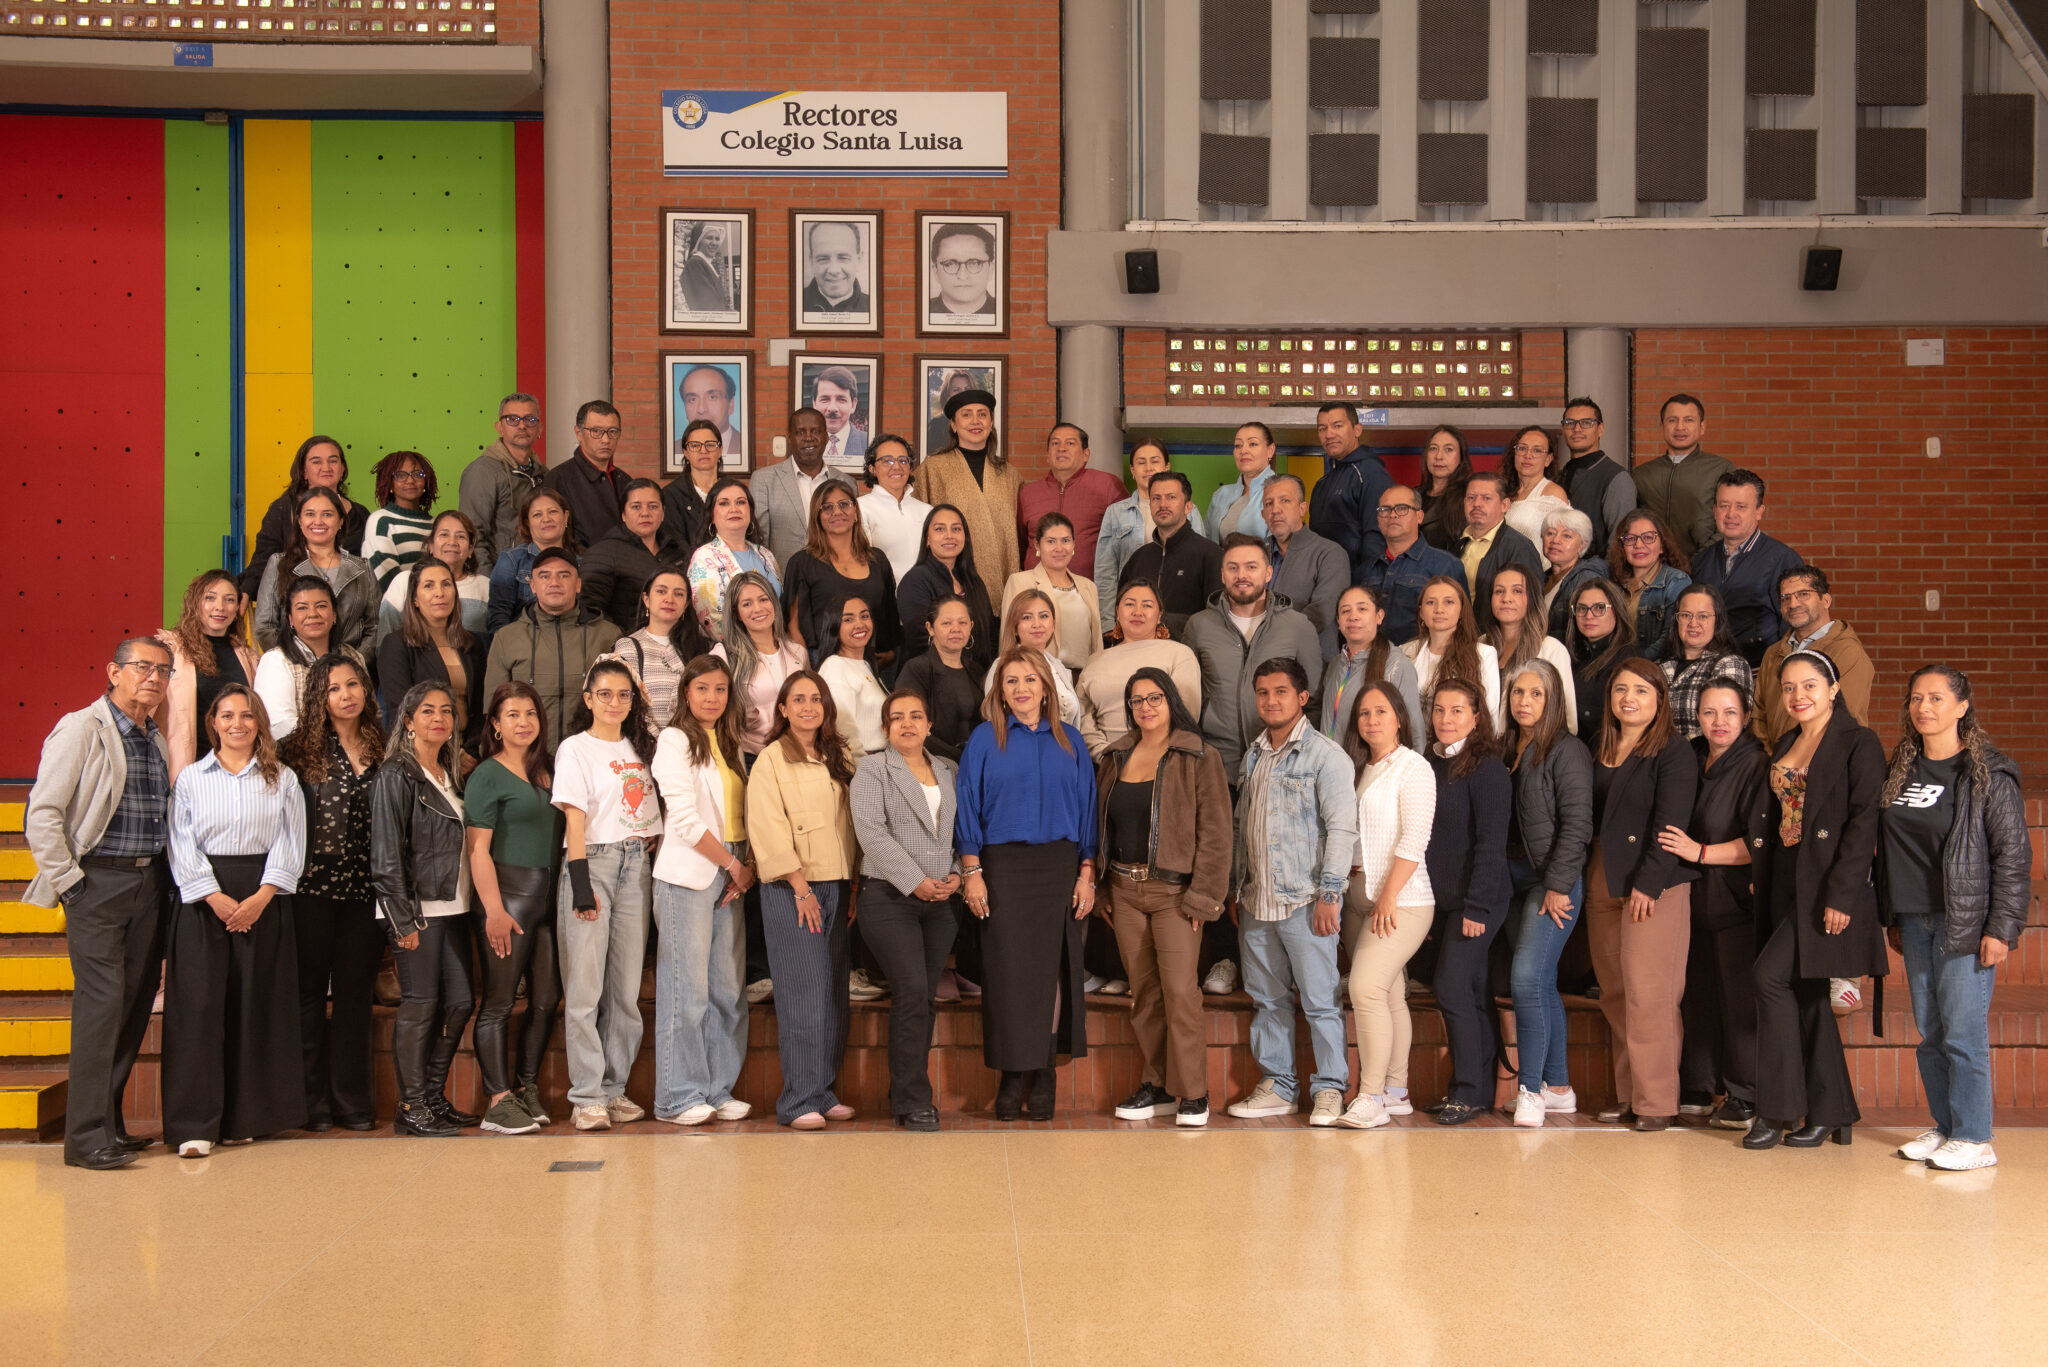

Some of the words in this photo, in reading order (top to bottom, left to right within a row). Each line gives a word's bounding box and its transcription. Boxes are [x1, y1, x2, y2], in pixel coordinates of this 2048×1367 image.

[782, 101, 898, 127] Rectores
[720, 129, 815, 157] Colegio
[823, 130, 892, 151] Santa
[898, 131, 964, 151] Luisa
